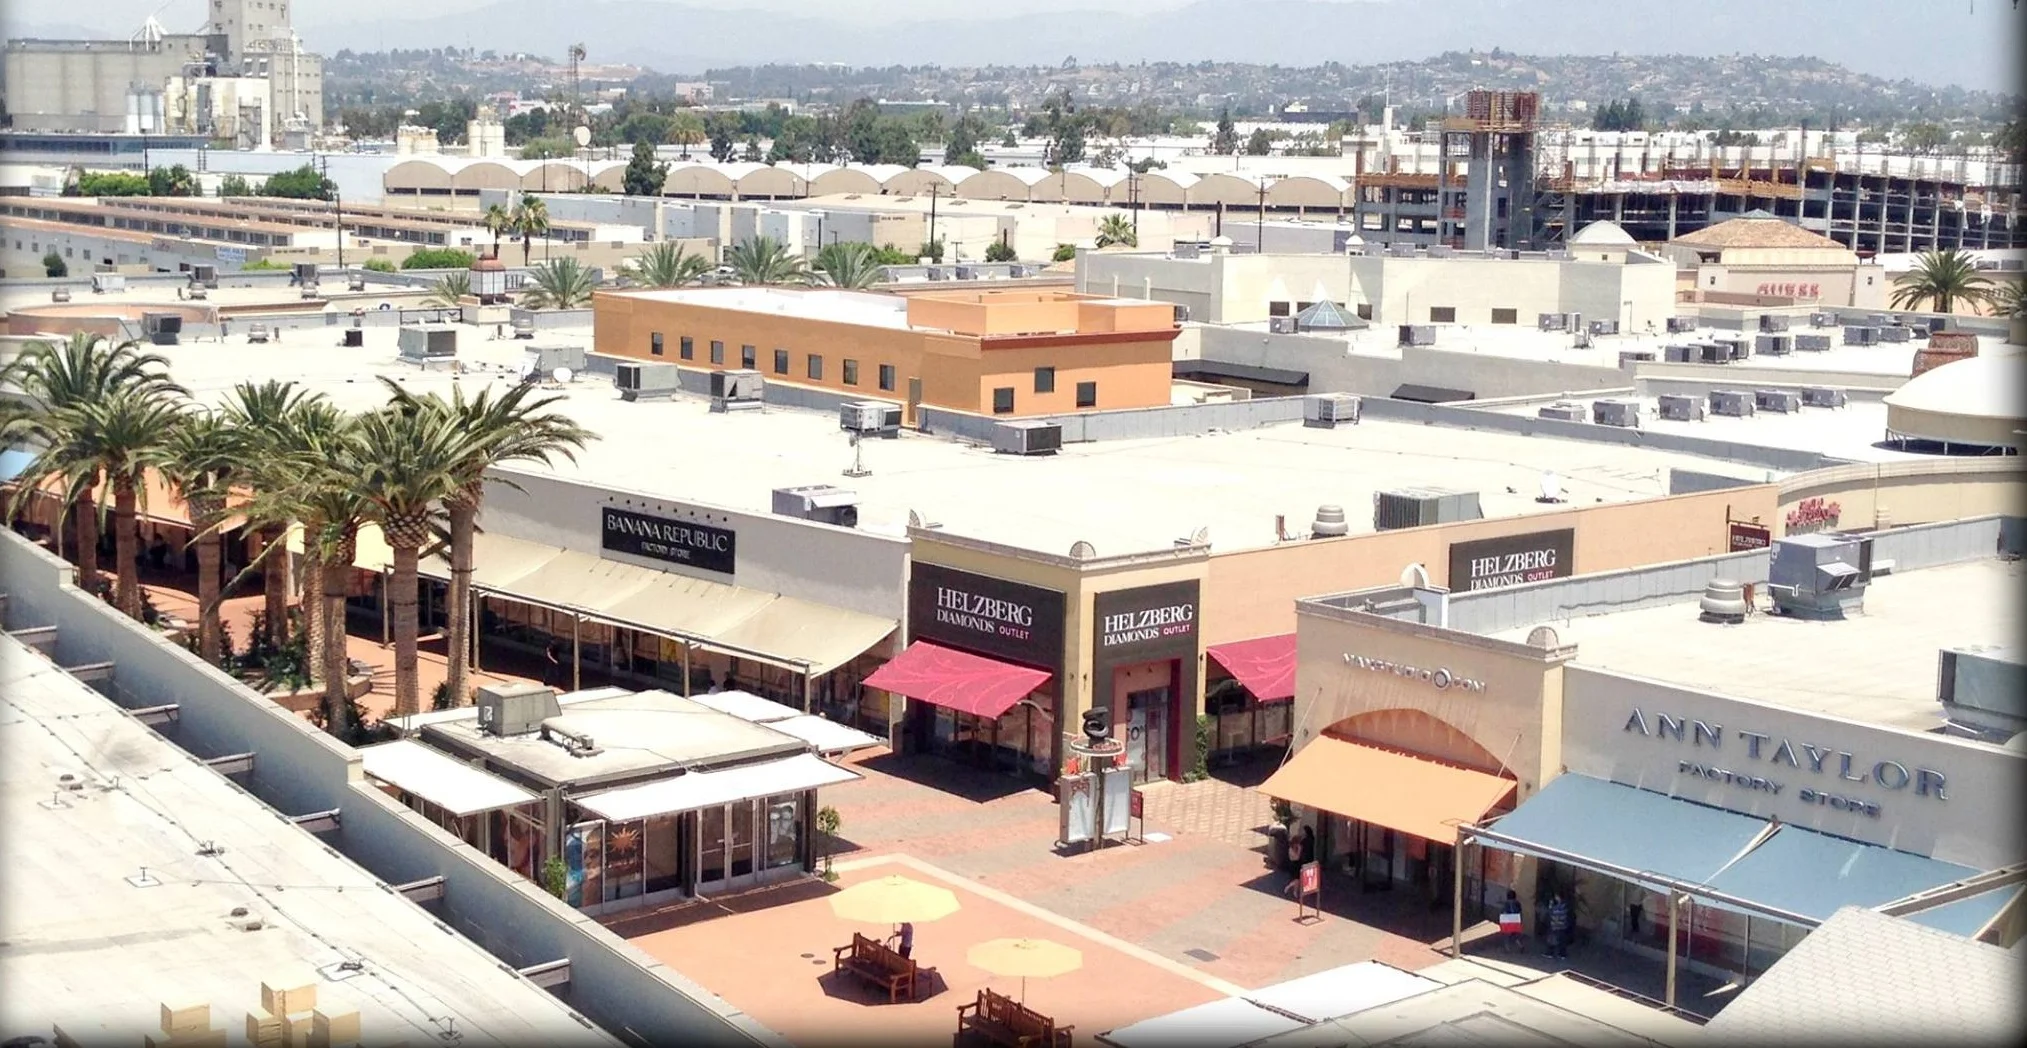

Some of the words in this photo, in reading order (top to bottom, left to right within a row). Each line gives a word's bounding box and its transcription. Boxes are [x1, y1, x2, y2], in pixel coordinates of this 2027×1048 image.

[607, 513, 661, 540] BANANA
[663, 524, 728, 552] REPUBLIC
[1471, 548, 1556, 578] HELZBERG
[1470, 573, 1524, 591] DIAMONDS
[1527, 570, 1554, 581] OUTLET
[937, 586, 1033, 627] HELZBERG
[1104, 603, 1193, 634] HELZBERG
[937, 608, 995, 633] DIAMONDS
[999, 625, 1030, 640] OUTLET
[1104, 627, 1160, 646] DIAMONDS
[1163, 624, 1190, 636] OUTLET
[1623, 706, 1723, 749] ANN
[1739, 730, 1950, 800] TAYLOR
[1678, 759, 1785, 795] FACTORY
[1800, 787, 1882, 817] STORE
